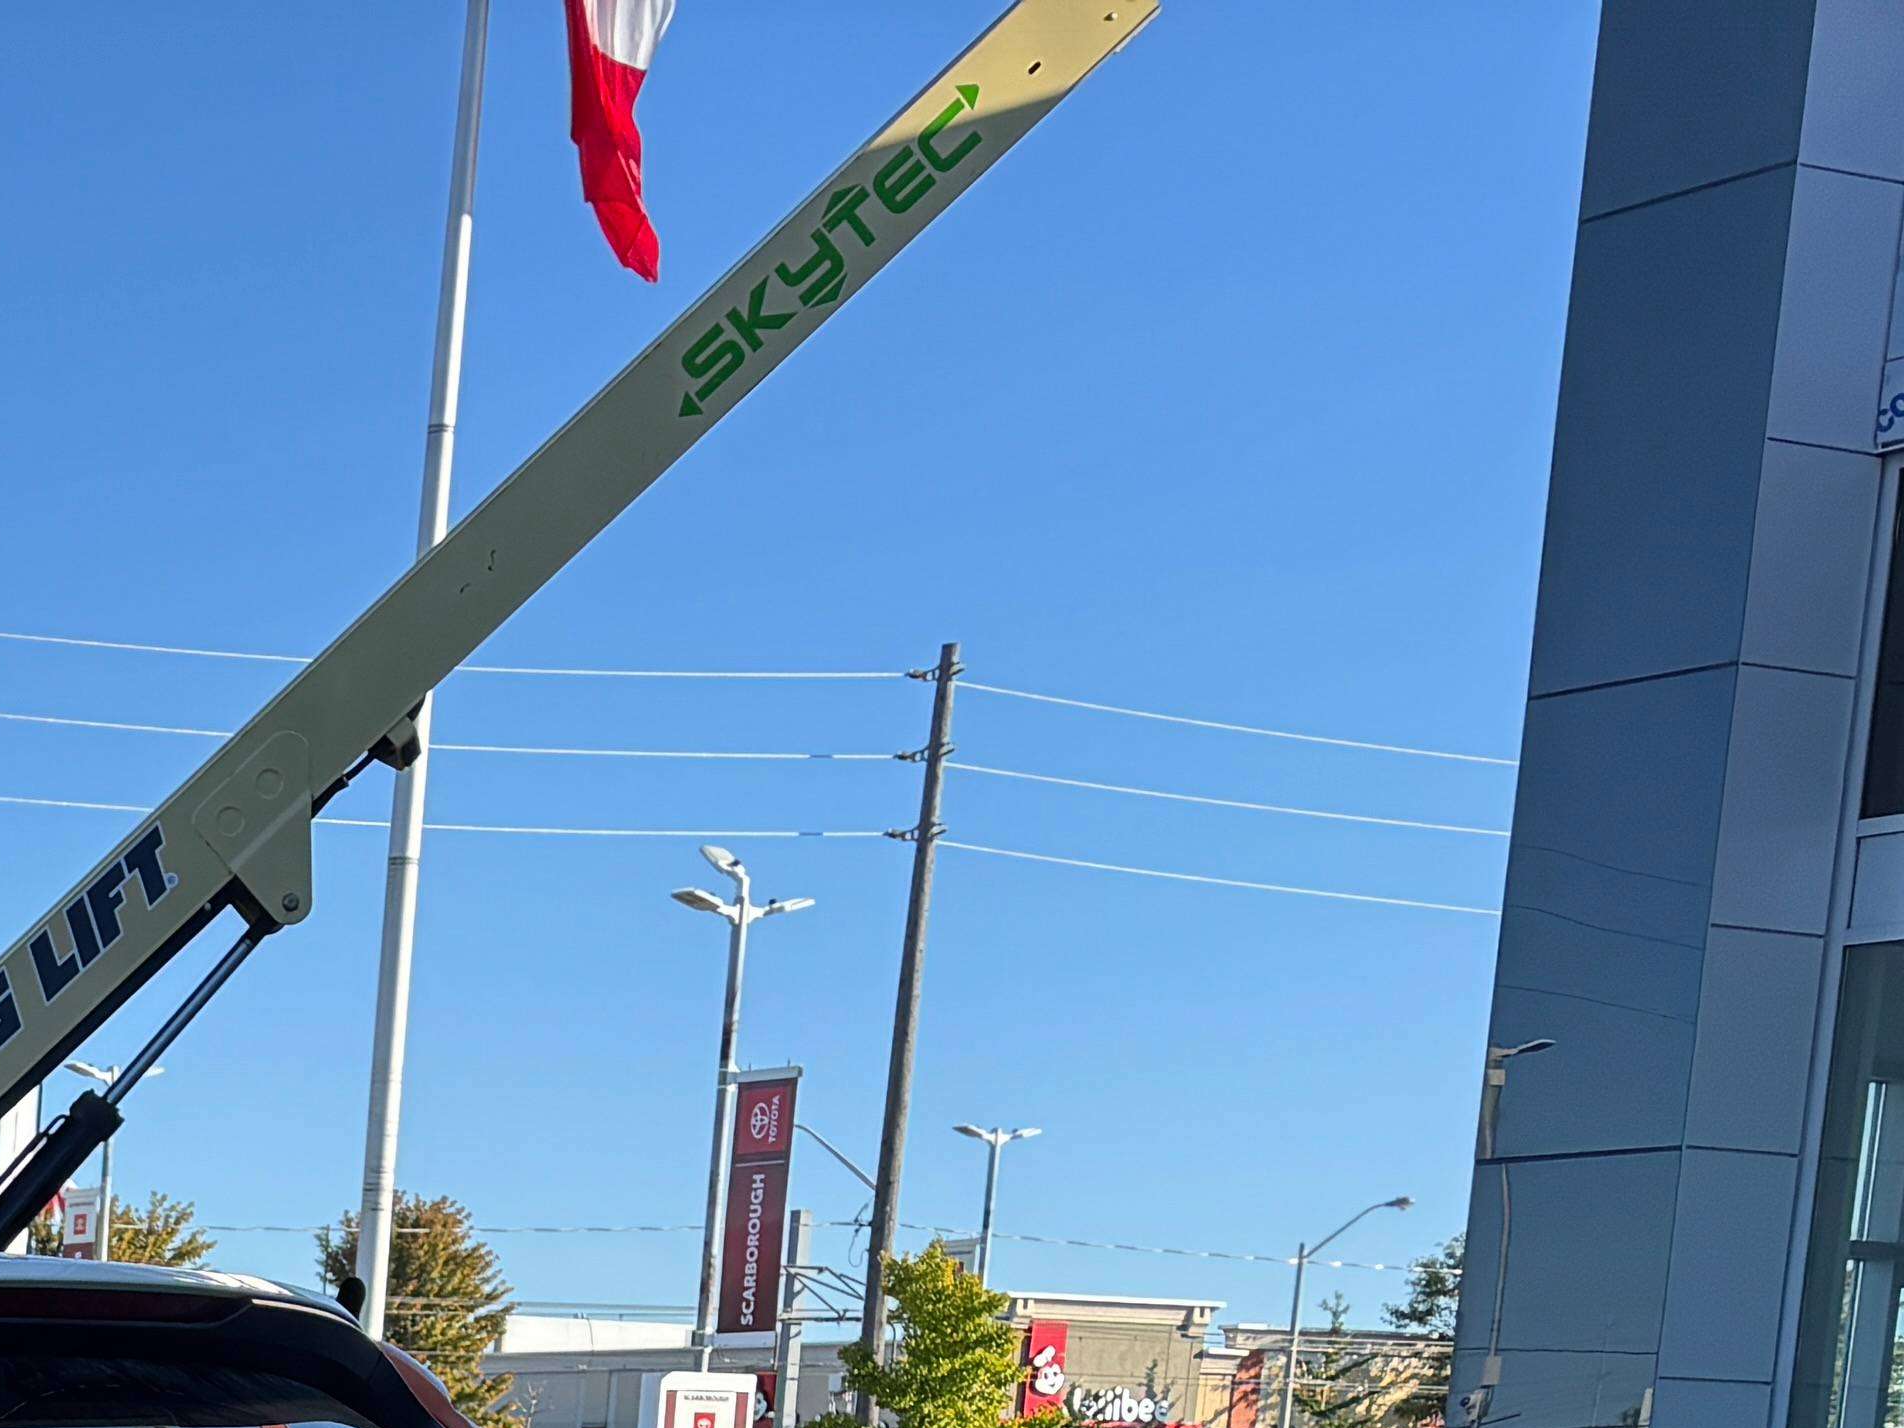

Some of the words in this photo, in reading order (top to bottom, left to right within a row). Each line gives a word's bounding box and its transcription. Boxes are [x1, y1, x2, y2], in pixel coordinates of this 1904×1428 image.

[678, 85, 983, 416] SKYTEC
[29, 820, 172, 1006] LIFT
[768, 1095, 781, 1144] TOYOTA
[741, 1173, 766, 1326] SCARBOROUGH
